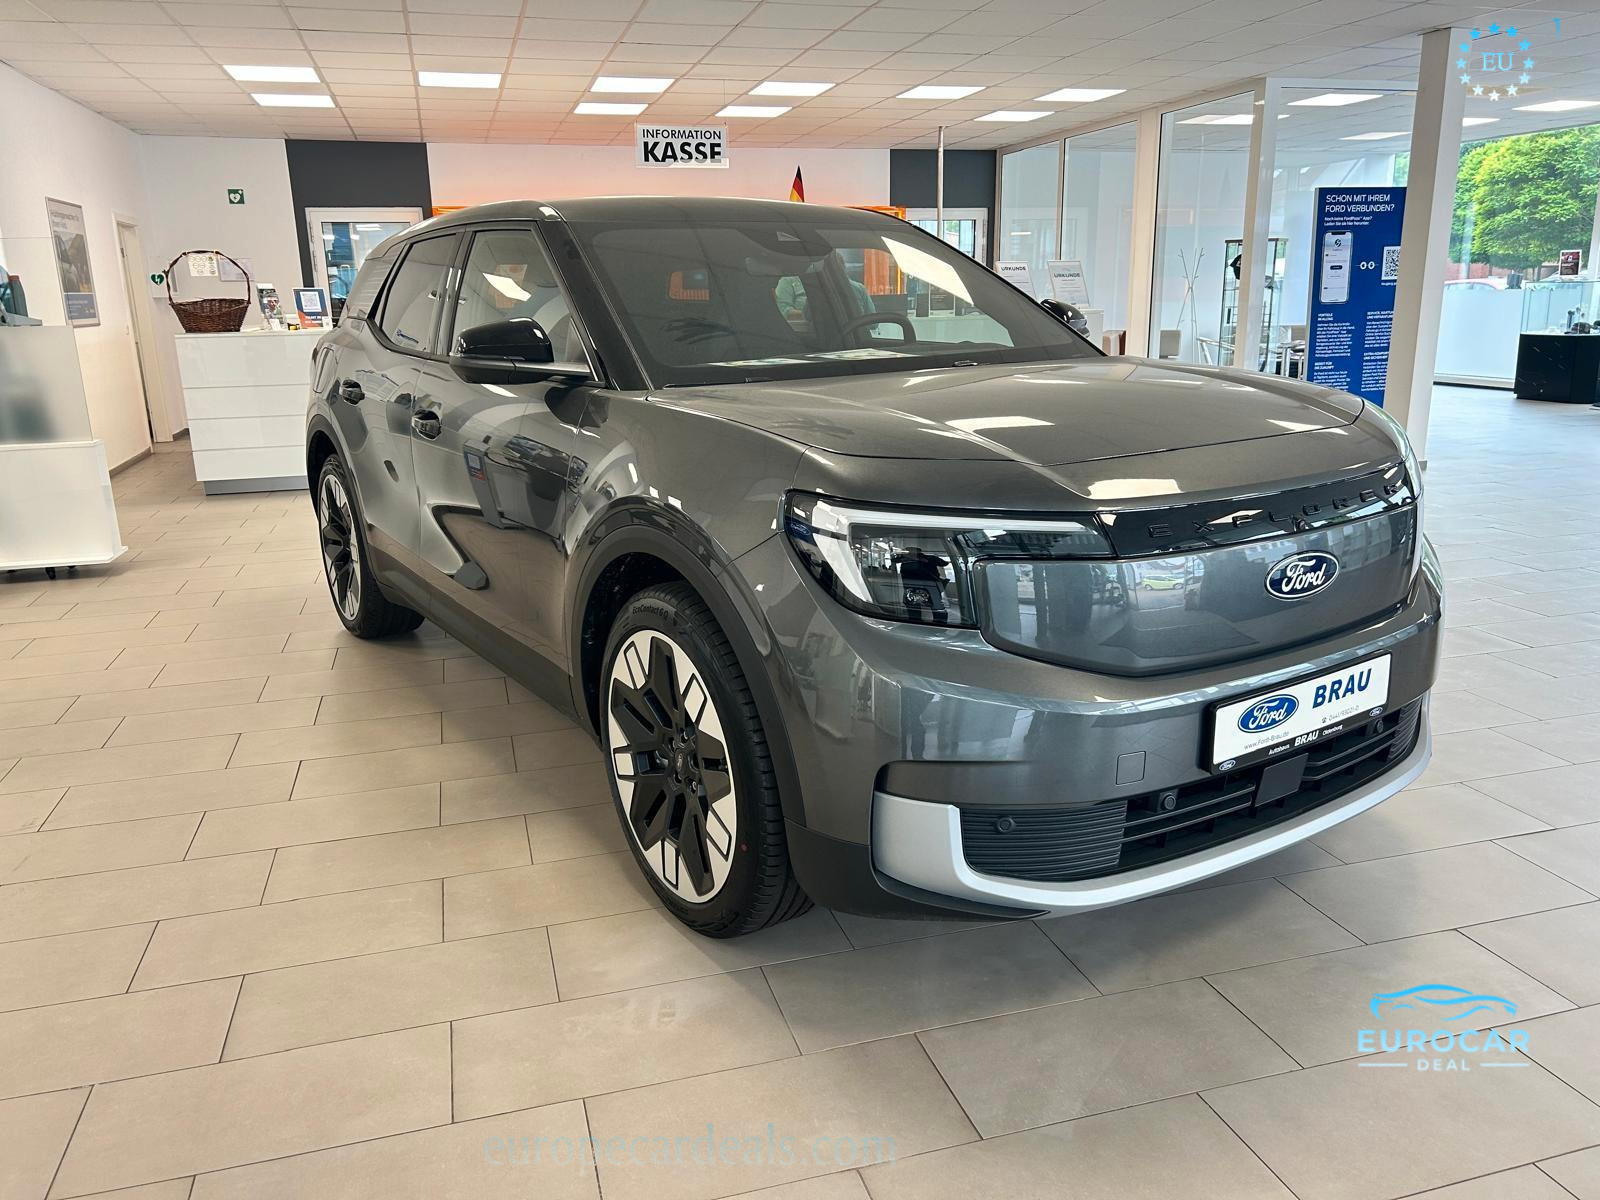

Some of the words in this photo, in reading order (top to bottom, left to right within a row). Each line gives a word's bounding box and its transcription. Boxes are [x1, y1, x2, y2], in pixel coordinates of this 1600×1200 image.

[642, 128, 722, 140] INFORMATION
[643, 141, 722, 163] KASSE
[1326, 194, 1352, 203] SCHON
[1353, 194, 1367, 202] MIT
[1367, 194, 1390, 202] IHREM
[1325, 204, 1346, 213] FORD
[1347, 204, 1395, 212] VERBUNDEN?
[1281, 560, 1327, 593] Ford
[1248, 699, 1289, 729] Ford
[1312, 668, 1373, 709] BRAU
[1294, 730, 1319, 747] BRAU
